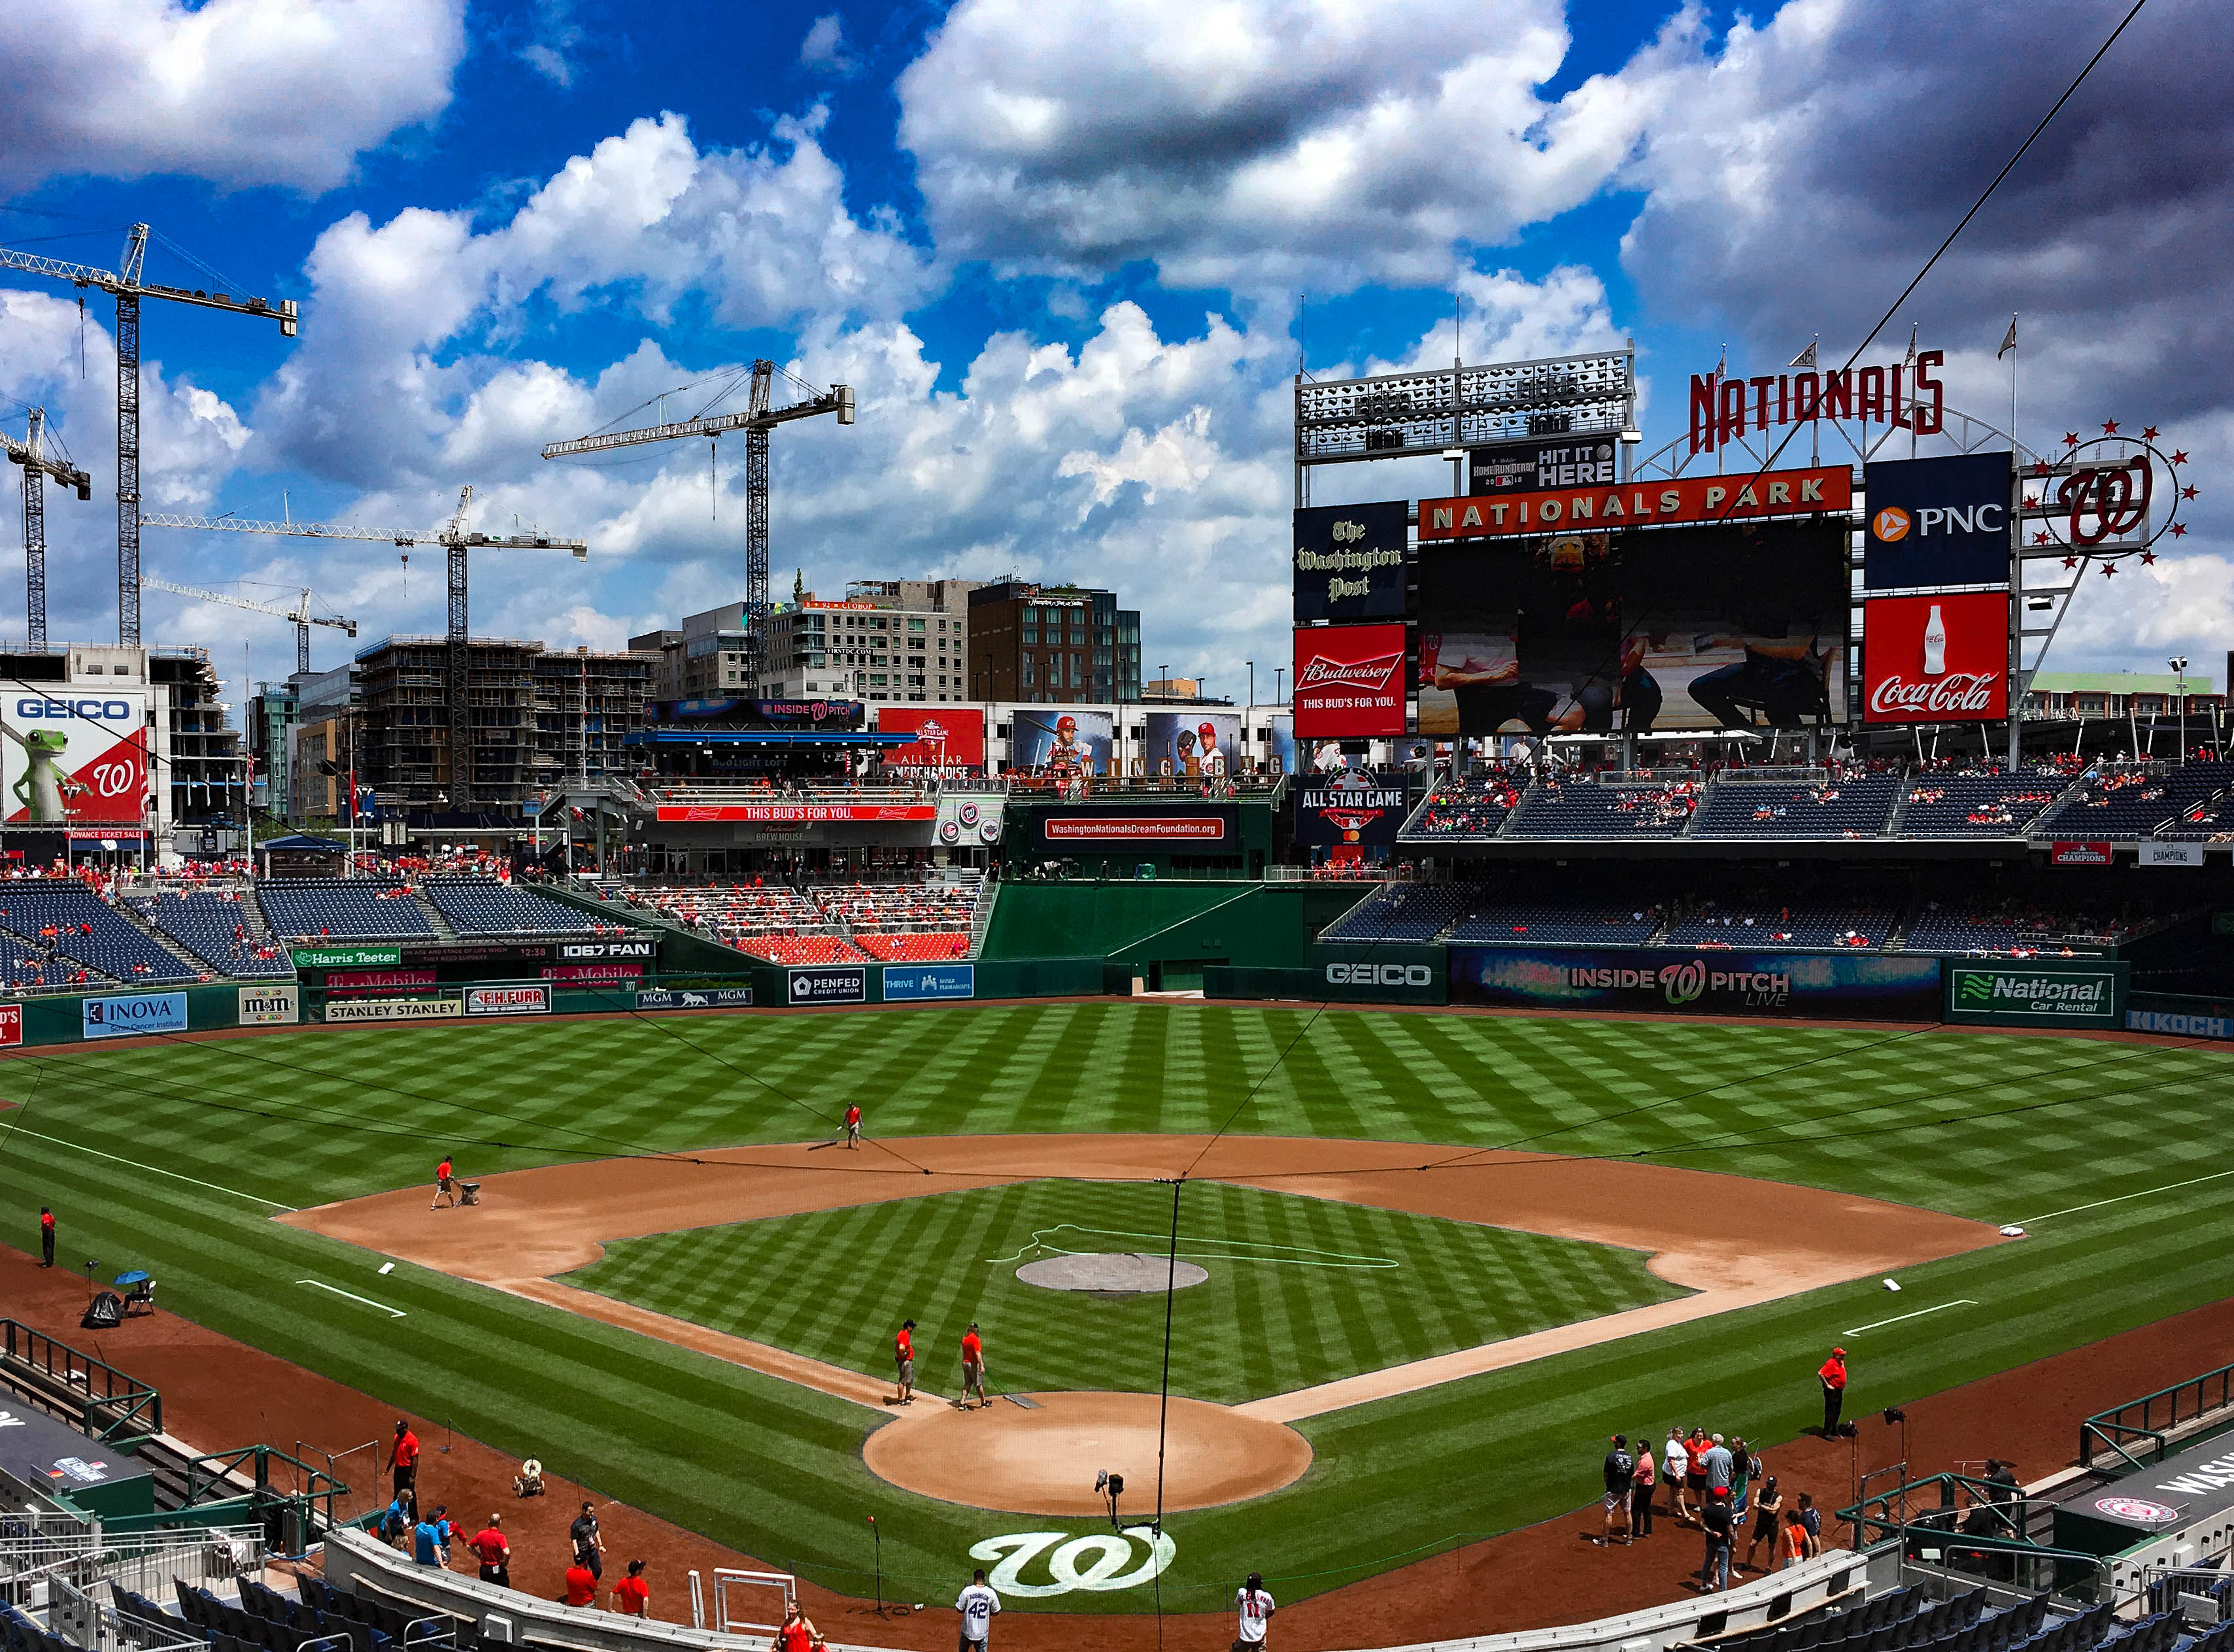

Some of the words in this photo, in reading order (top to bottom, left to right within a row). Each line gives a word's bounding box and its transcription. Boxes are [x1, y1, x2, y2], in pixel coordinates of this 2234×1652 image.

[1689, 349, 1944, 454] NATIONALS
[1539, 448, 1569, 465] HIT
[1575, 447, 1593, 462] IT
[1473, 465, 1494, 477] HOME
[1494, 464, 1510, 475] RUN
[1510, 462, 1536, 474] DERBY
[1538, 461, 1613, 487] HERE
[1432, 490, 1680, 530] NATIONALS
[1706, 477, 1824, 509] PARK
[2057, 454, 2153, 545] W
[1917, 503, 2003, 536] PNC
[1332, 520, 1366, 543] The
[1296, 547, 1402, 572] Washington
[1328, 576, 1370, 603] Post
[1304, 662, 1391, 682] Budweiser
[1870, 671, 2001, 713] Coca-Cola
[16, 699, 130, 720] GEICO
[774, 705, 809, 714] INSIDE
[828, 706, 850, 715] PITCH
[1302, 699, 1323, 709] THIS
[1325, 698, 1353, 709] BUD'S
[1355, 697, 1372, 707] FOR
[1374, 696, 1396, 707] YOU.
[734, 758, 761, 767] LIGHT
[764, 758, 788, 767] LOFT
[901, 755, 924, 764] ALL
[932, 755, 962, 765] STAR
[93, 759, 134, 798] W
[1329, 791, 1363, 807] STAR
[1366, 791, 1402, 807] GAME
[746, 807, 770, 818] THIS
[773, 807, 805, 818] BUD'S
[807, 807, 827, 818] FOR
[829, 807, 854, 818] YOU.
[756, 833, 777, 841] BREW
[779, 832, 804, 841] HOUSE
[1051, 824, 1215, 835] WashingtonNationalsDreamFoundation.org
[2153, 851, 2188, 862] CHAMPIONS
[312, 952, 354, 964] Harris
[356, 951, 397, 963] Teeter
[521, 948, 546, 956] 12:38
[563, 945, 605, 957] 106.7
[609, 943, 649, 956] FAN
[1326, 963, 1431, 986] GEICO
[1571, 968, 1655, 989] INSIDE
[1710, 971, 1790, 993] PITCH
[625, 981, 636, 992] 377
[813, 979, 860, 988] PENFED
[885, 979, 914, 988] THRIVE
[1993, 977, 2102, 1001] National
[643, 993, 672, 1002] MGM
[717, 990, 746, 1000] MGM
[1744, 992, 1787, 1007] LIVE
[110, 1000, 172, 1020] INOVA
[330, 1005, 392, 1018] STANLEY
[397, 1003, 456, 1015] STANLEY
[2030, 1001, 2053, 1011] Car
[2056, 1002, 2097, 1012] Rental
[156, 1020, 183, 1028] Institute
[2154, 1013, 2224, 1038] KOCH
[2155, 1452, 2234, 1496] WAS
[968, 1601, 989, 1619] 42
[1247, 1602, 1260, 1618] 11
